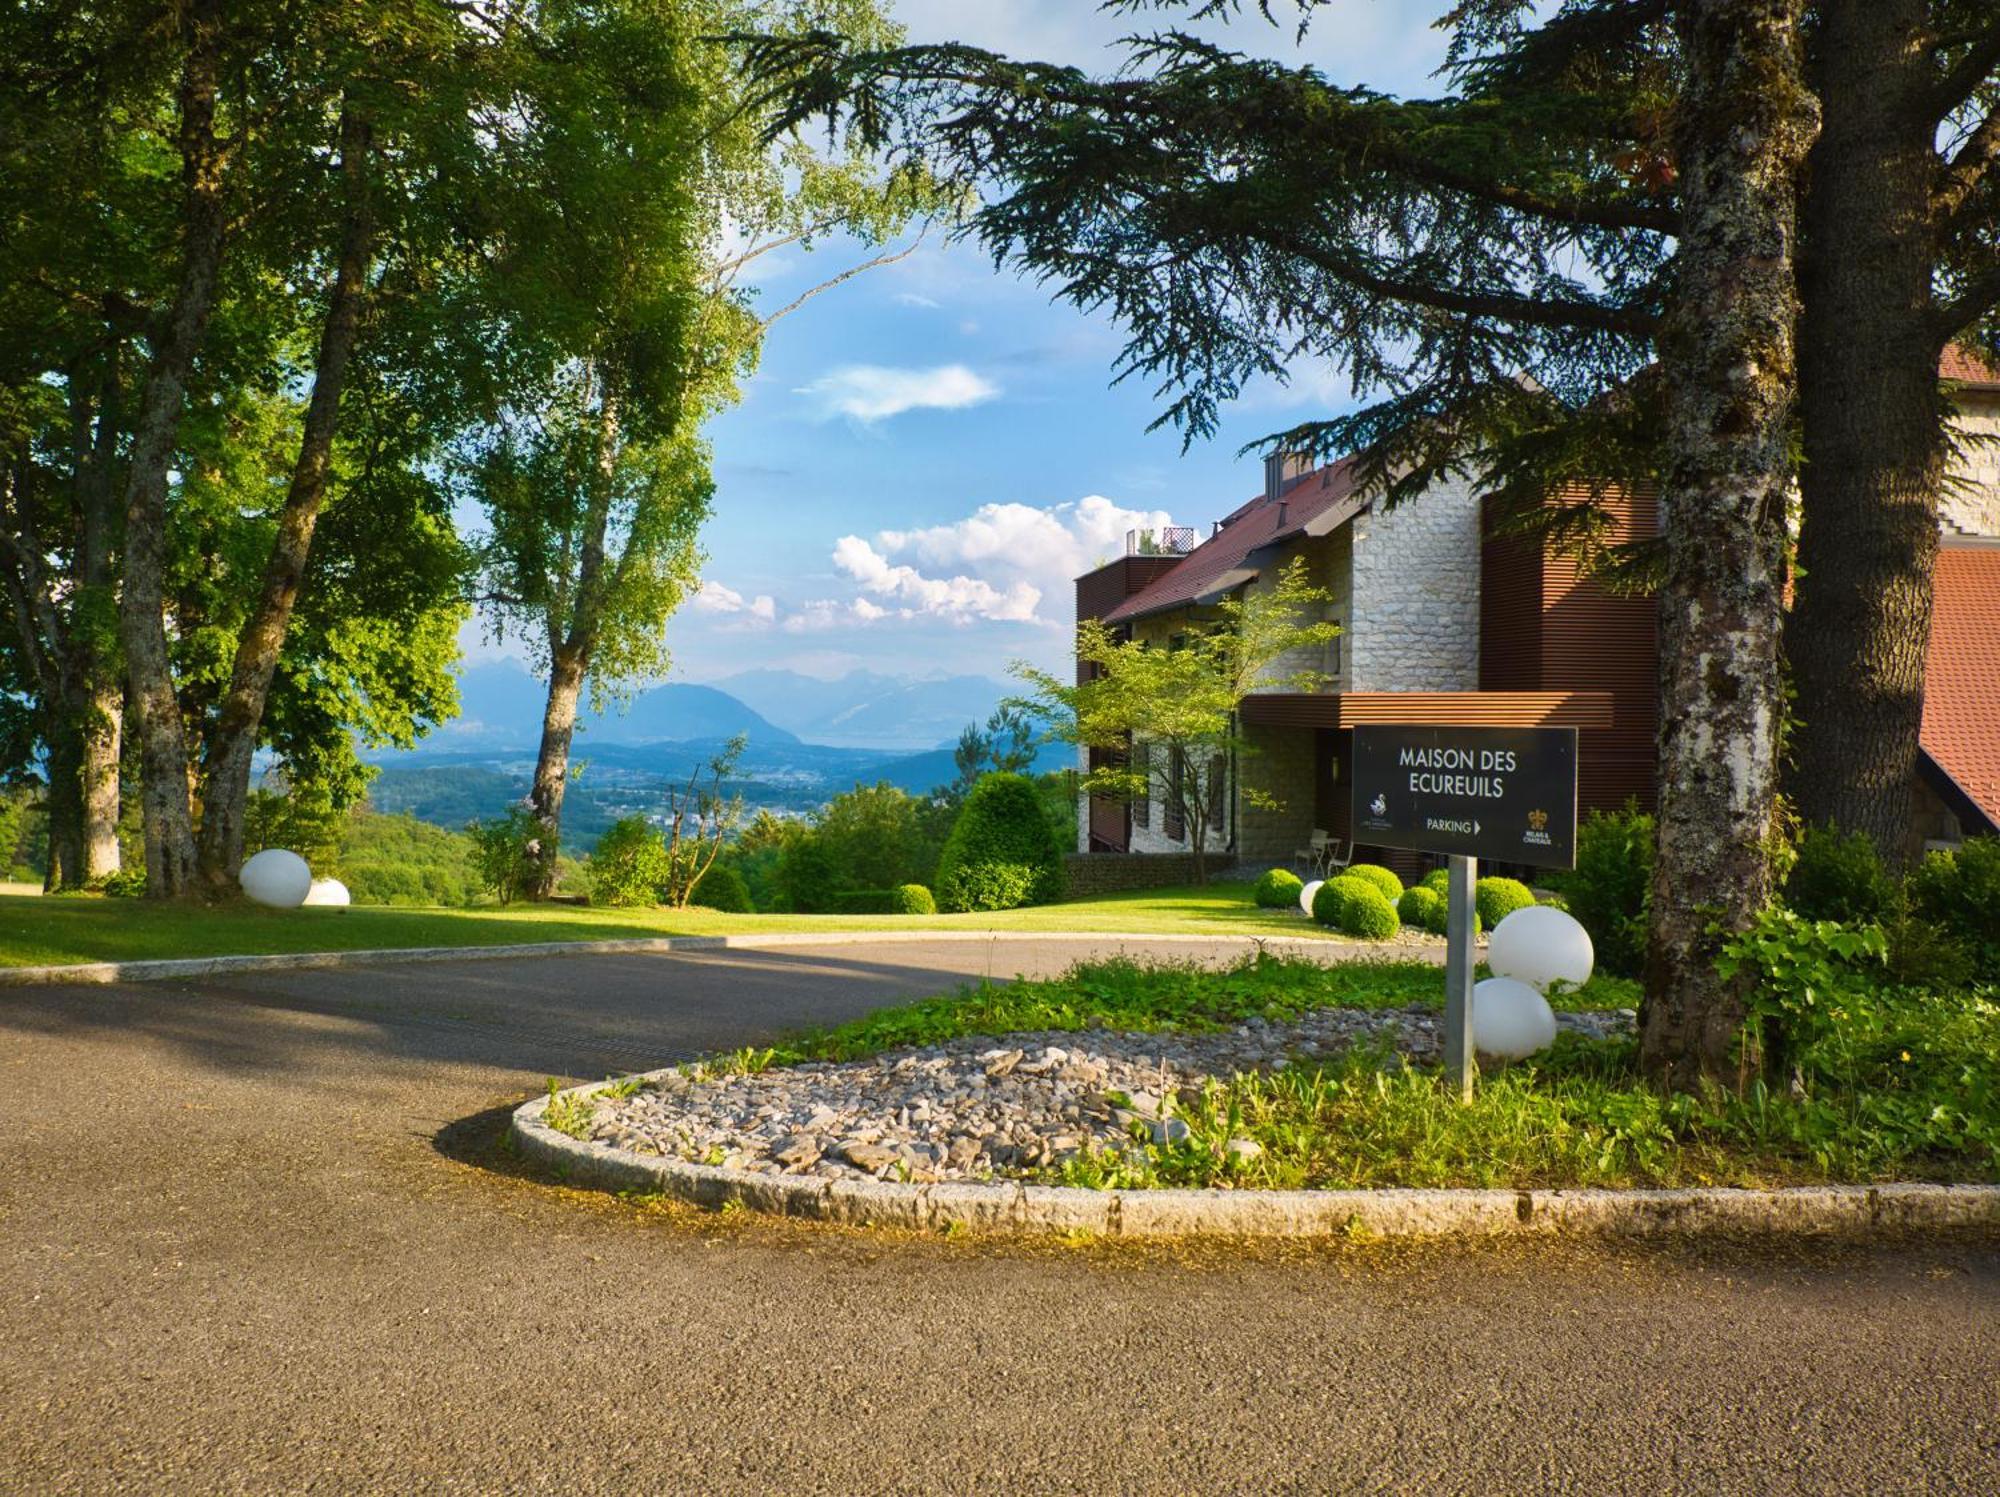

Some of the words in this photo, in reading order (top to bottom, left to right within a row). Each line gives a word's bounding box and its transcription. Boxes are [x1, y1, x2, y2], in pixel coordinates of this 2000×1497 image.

[1399, 747, 1474, 769] MAISON
[1480, 750, 1516, 772] DES
[1409, 773, 1504, 798] ECUREUILS
[1426, 818, 1471, 834] PARKING
